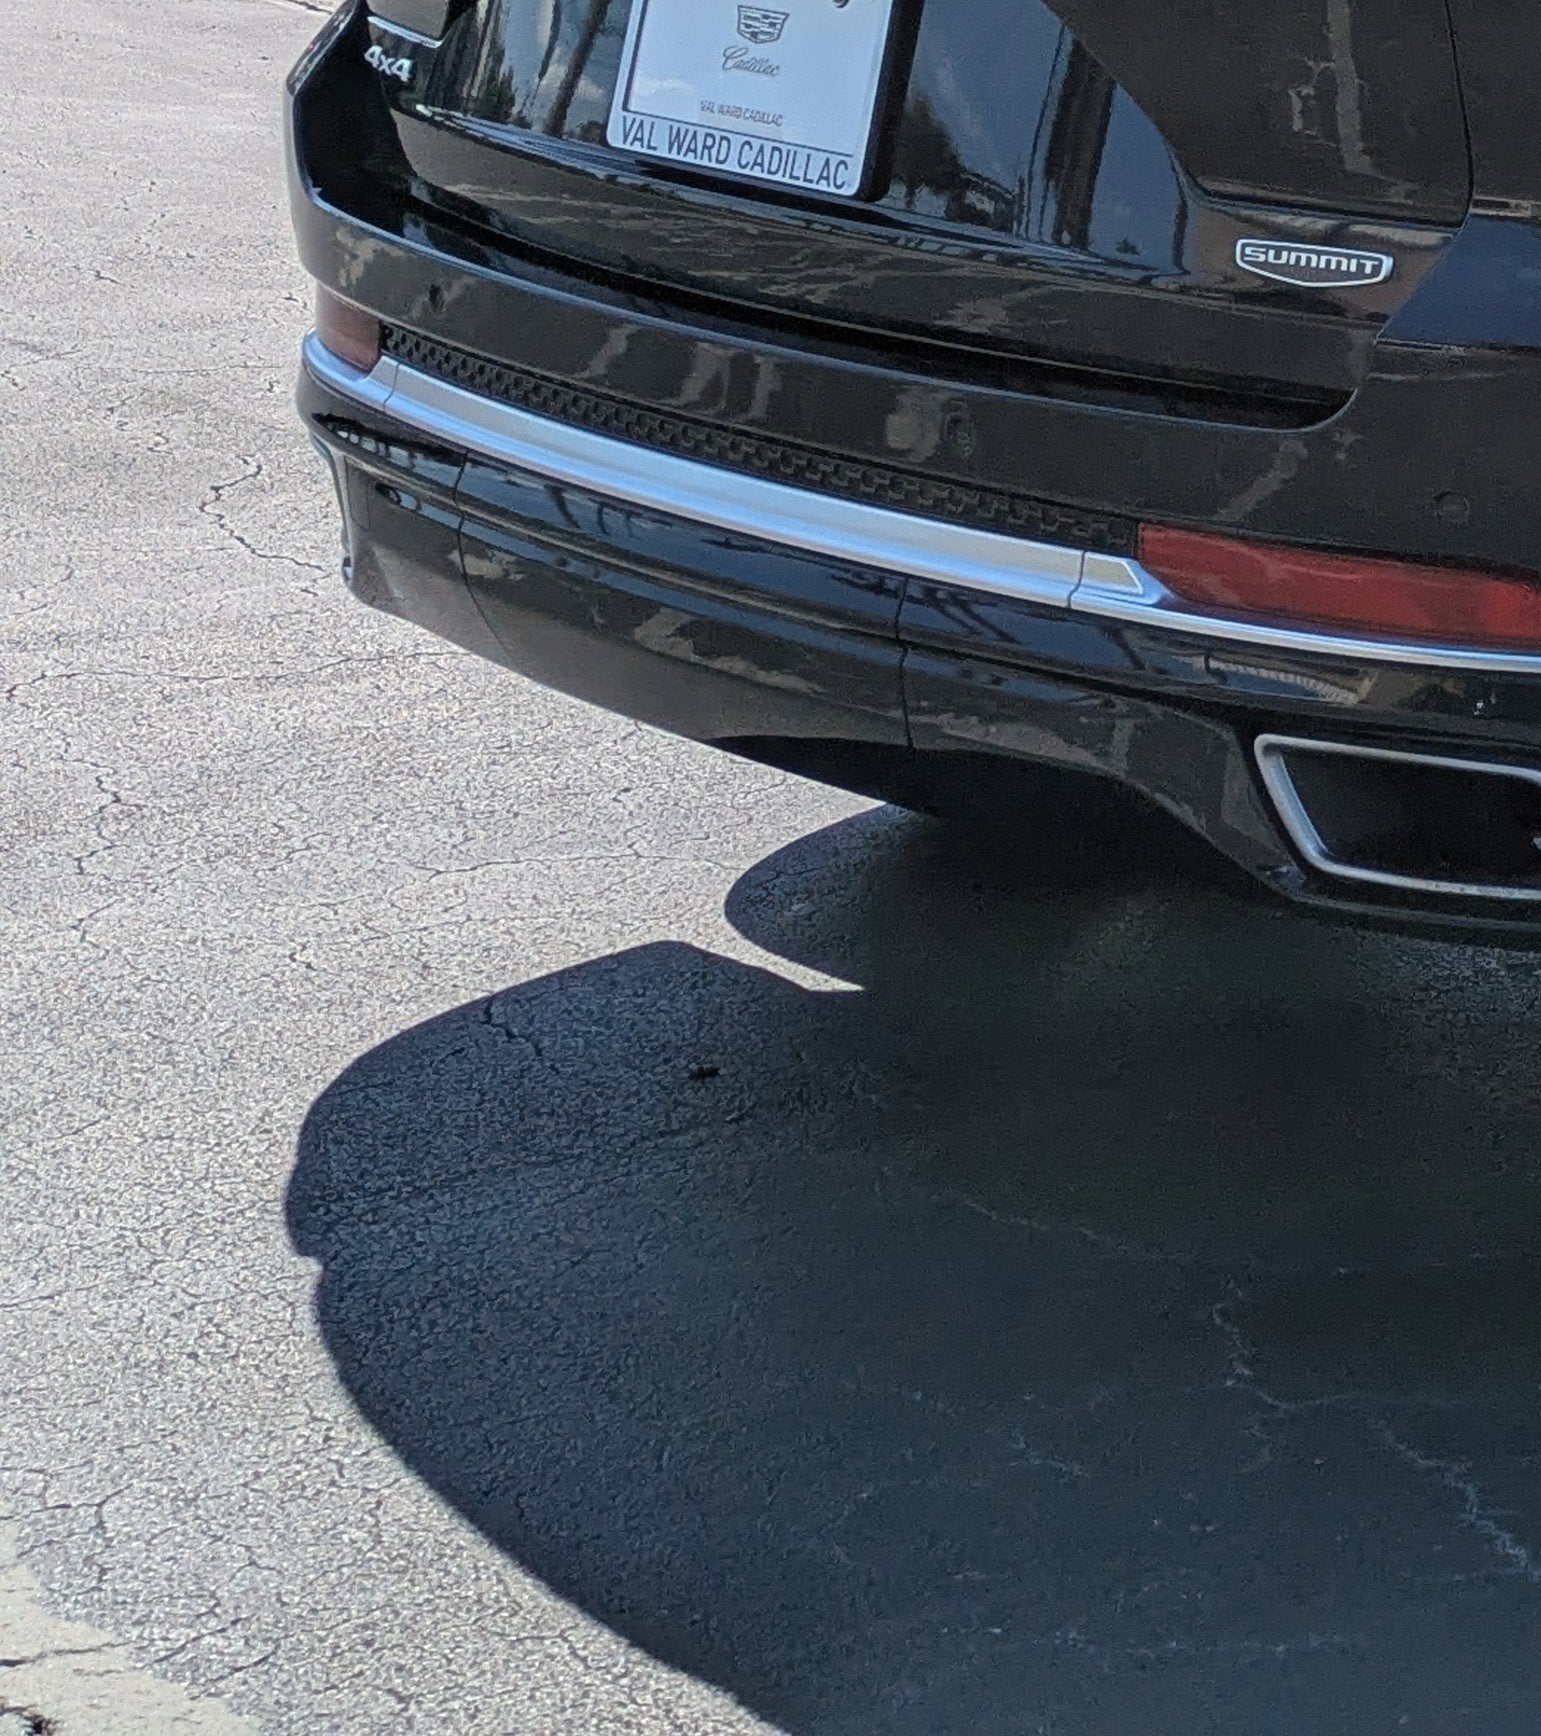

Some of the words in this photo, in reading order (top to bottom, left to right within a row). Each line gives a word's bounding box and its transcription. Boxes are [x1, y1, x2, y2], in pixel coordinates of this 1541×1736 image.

[723, 45, 780, 77] Cadillac
[621, 115, 659, 152] VAL
[667, 125, 732, 165] WARD
[736, 140, 850, 191] CADILLAC
[1243, 246, 1380, 275] SUMMIT
